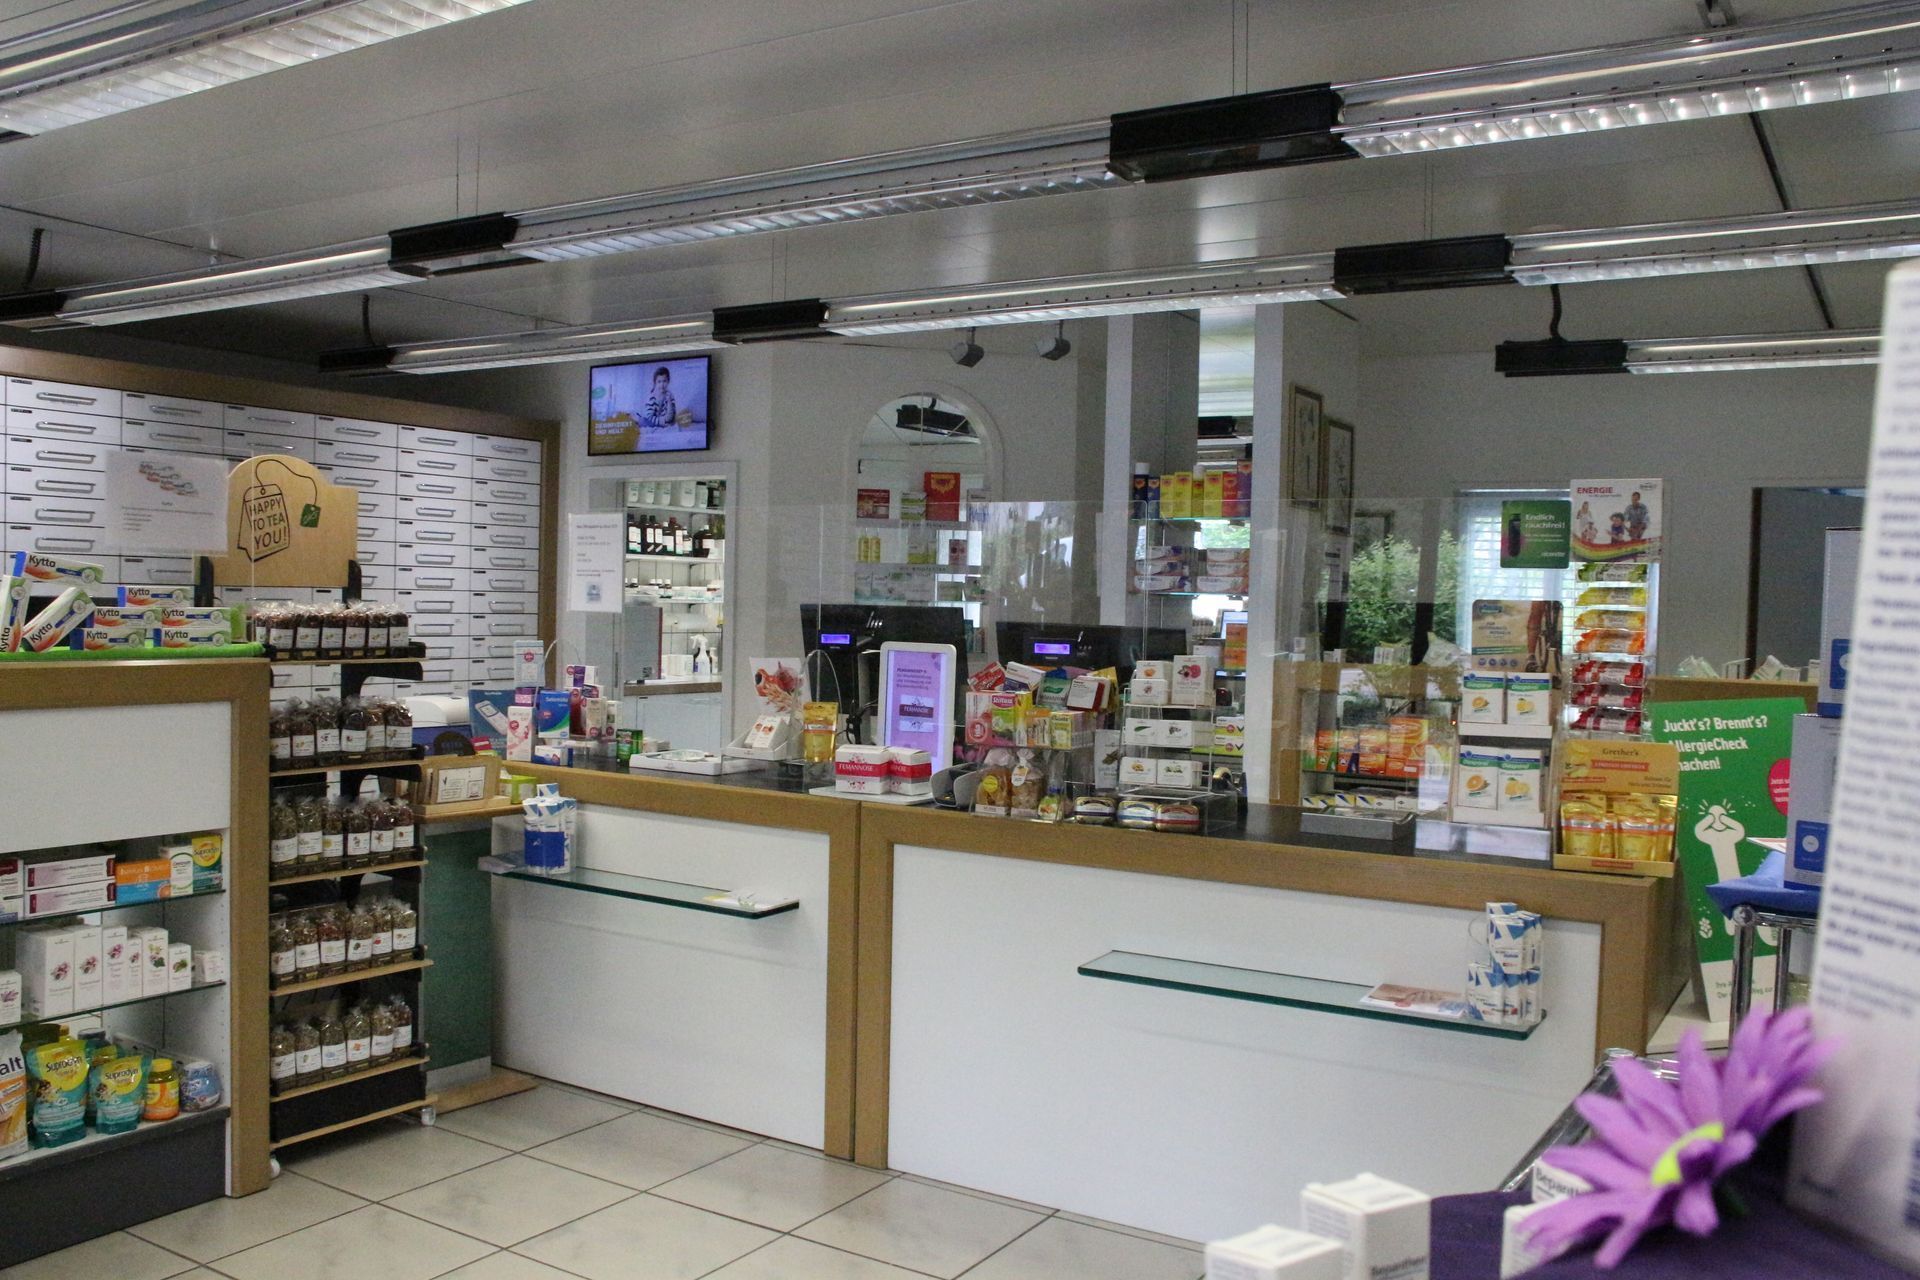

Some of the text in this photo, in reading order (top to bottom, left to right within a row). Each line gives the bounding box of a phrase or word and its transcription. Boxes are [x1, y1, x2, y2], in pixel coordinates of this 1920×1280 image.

[1576, 486, 1614, 494] ENERGIE
[249, 497, 281, 516] HAPPY
[253, 511, 285, 532] TO TEA
[1525, 521, 1566, 529] rauchfrei!
[254, 526, 287, 550] YOU!
[28, 555, 56, 568] Kytta
[128, 587, 150, 597] Kytta
[97, 609, 119, 618] Kytta
[162, 609, 184, 617] Kytta
[29, 622, 53, 644] Kytta
[86, 631, 108, 640] Kytta
[164, 630, 188, 639] Kytta
[0, 627, 11, 652] Kytta
[1663, 715, 1768, 733] Juckt's? Brennt's?
[1668, 737, 1748, 755] llergieCheck
[1602, 748, 1639, 756] Grether's
[839, 763, 874, 772] FEMANNOSE
[0, 1056, 23, 1076] alt
